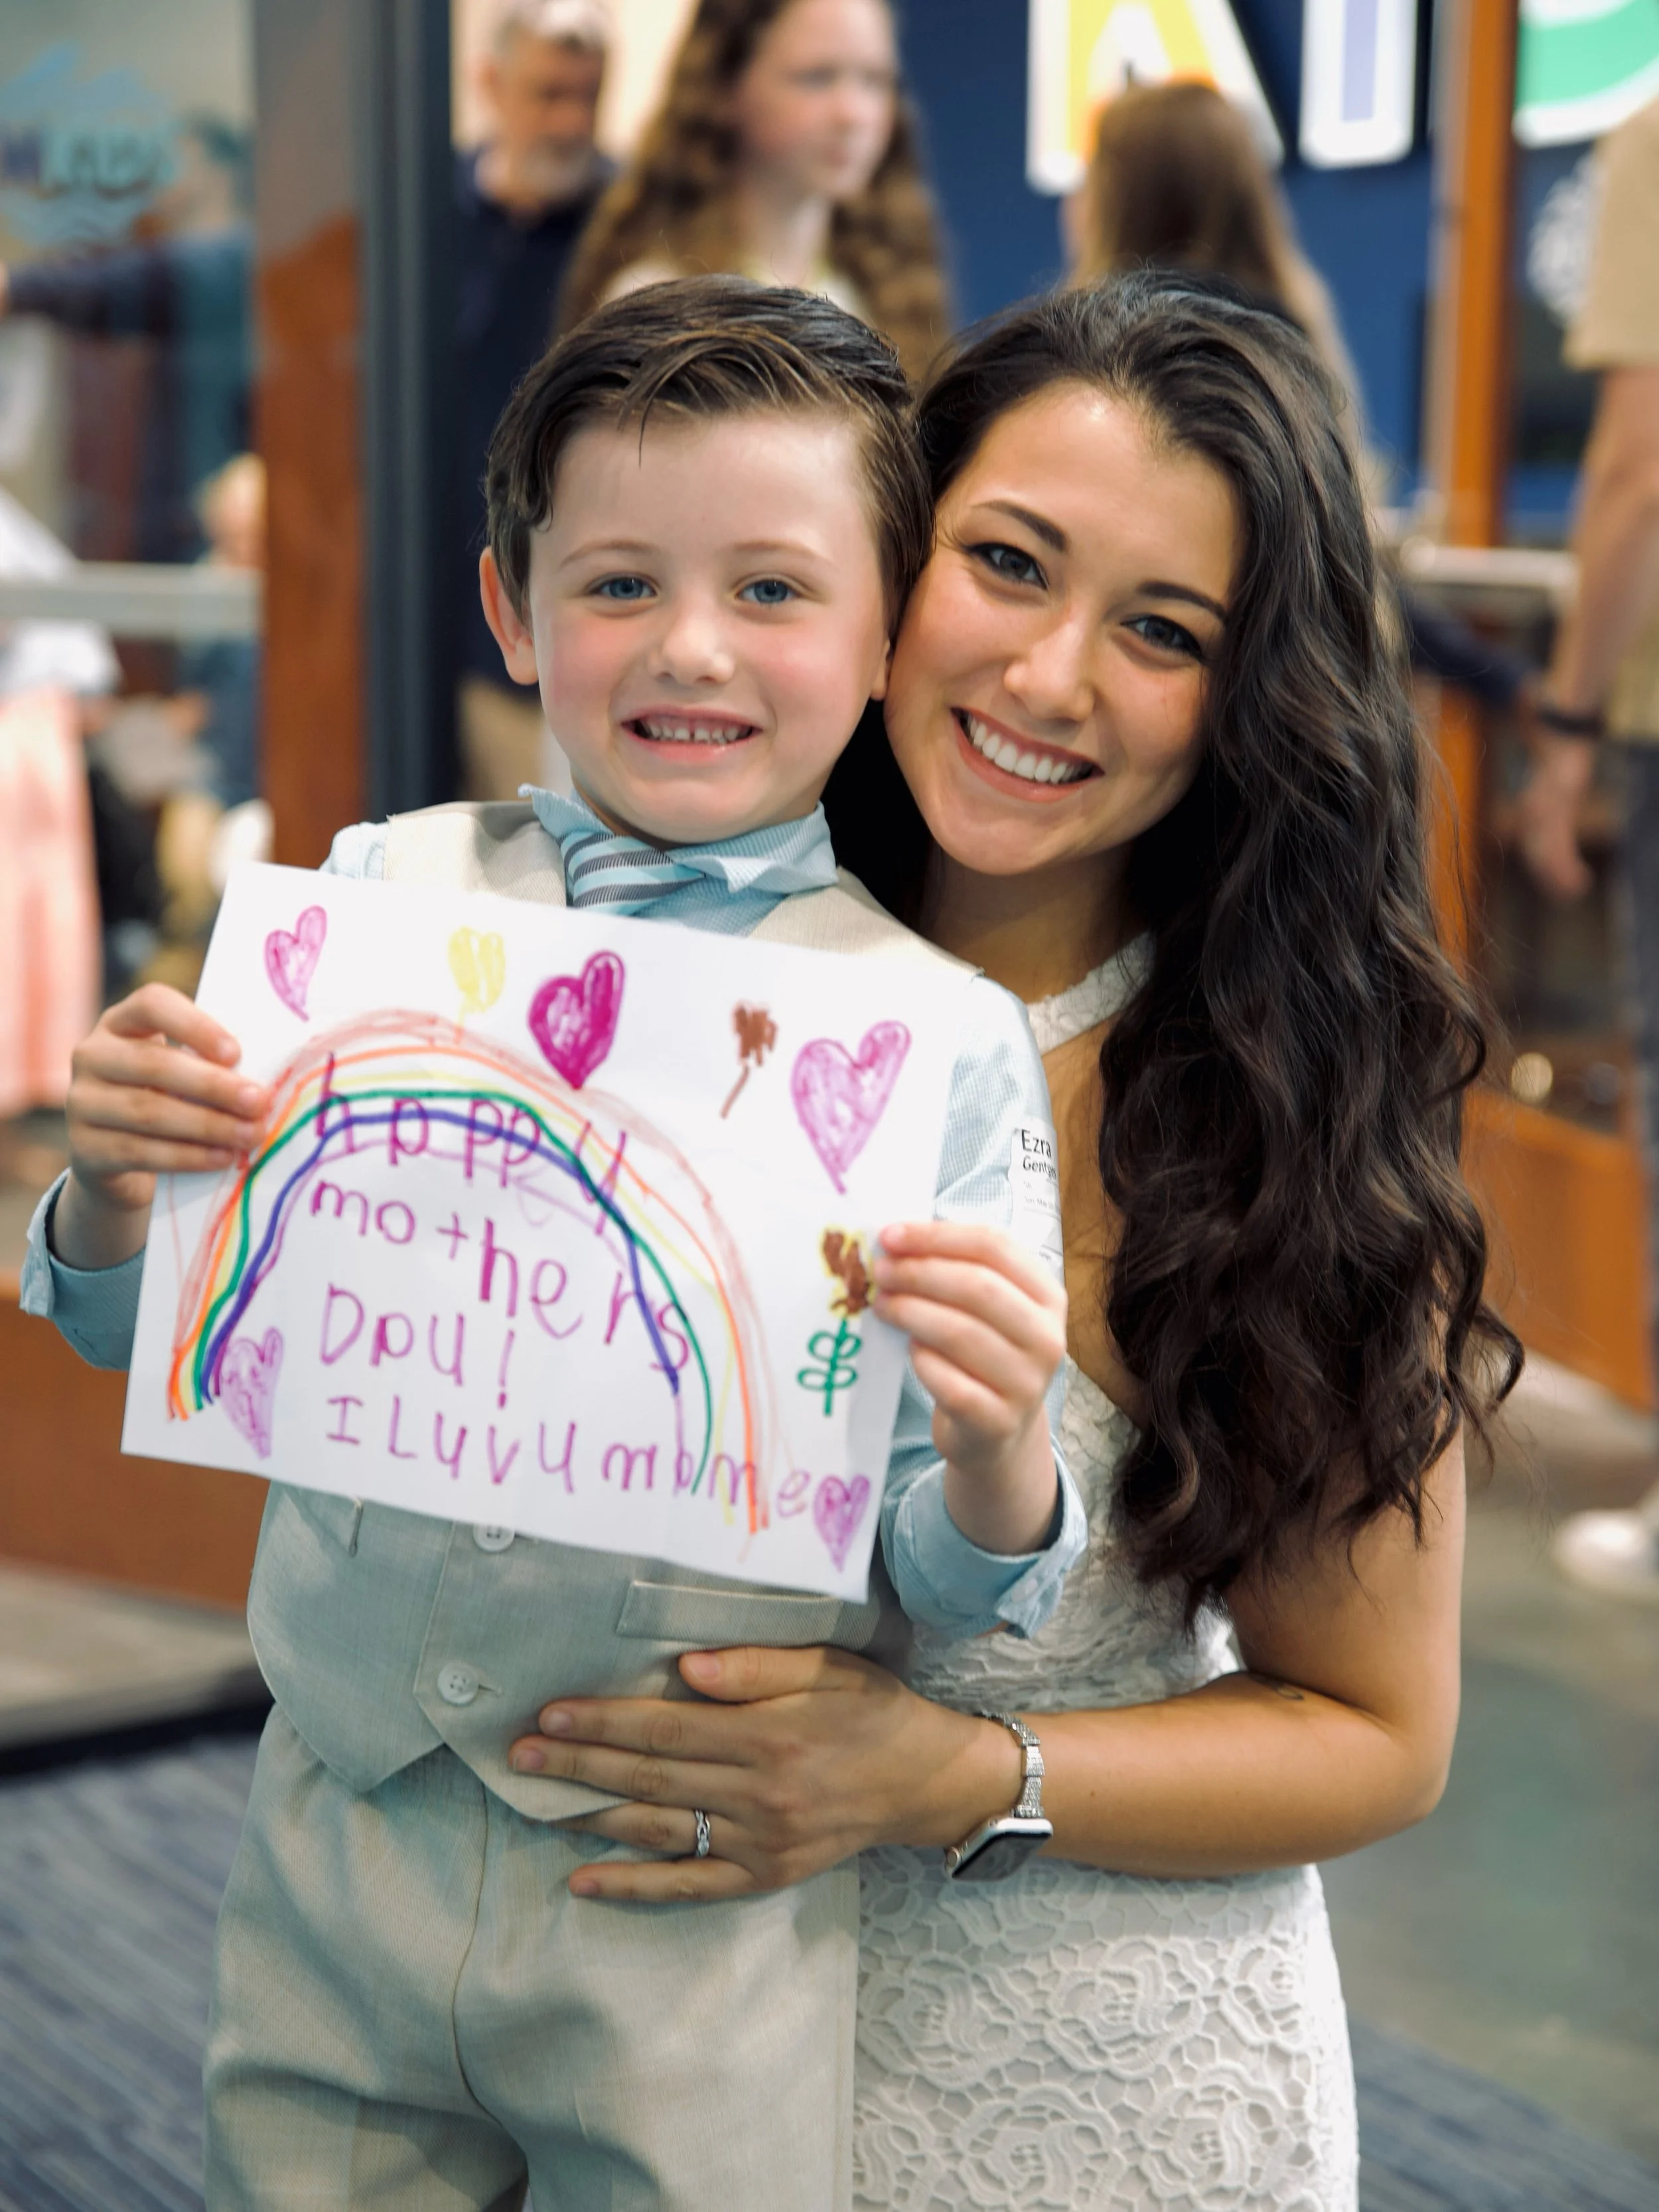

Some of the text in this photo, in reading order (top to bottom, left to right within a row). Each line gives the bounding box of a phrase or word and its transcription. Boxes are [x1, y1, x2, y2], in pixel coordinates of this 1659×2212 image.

[1022, 1129, 1051, 1159] Ezra
[311, 1180, 689, 1371] mothers
[326, 1396, 363, 1445] I
